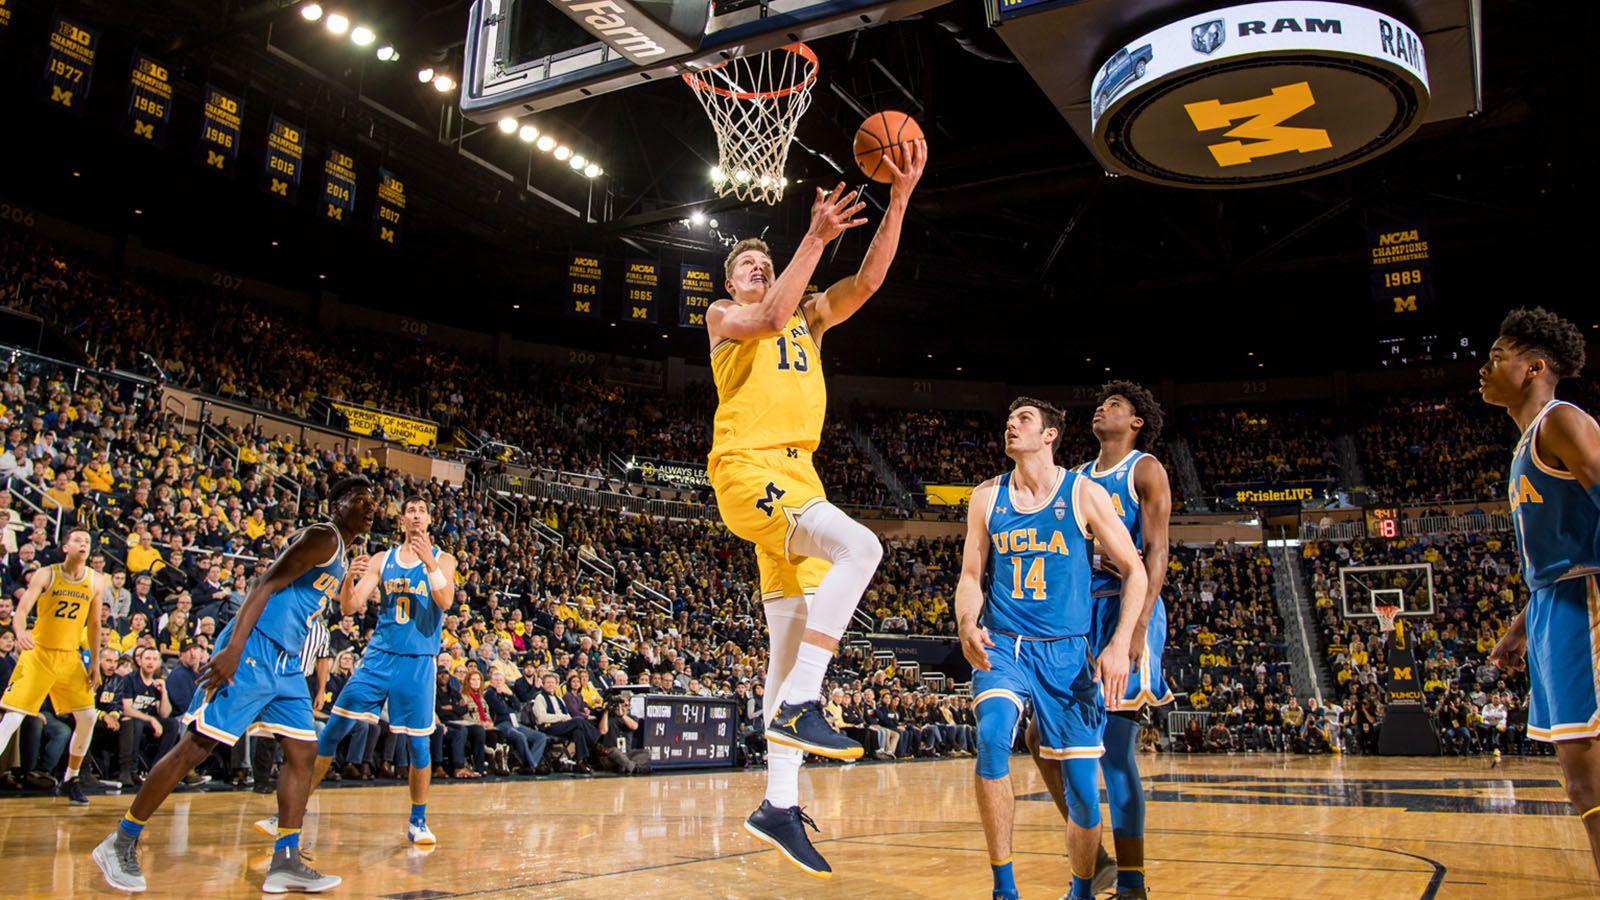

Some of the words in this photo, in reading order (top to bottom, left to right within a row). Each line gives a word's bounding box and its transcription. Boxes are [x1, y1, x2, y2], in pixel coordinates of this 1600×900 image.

[568, 1, 667, 58] Farm
[51, 32, 96, 59] CHAMPIONS
[1237, 18, 1343, 37] RAM
[1379, 18, 1423, 73] RAM
[50, 58, 84, 83] 1977
[50, 84, 73, 107] M
[133, 95, 165, 118] 1985
[133, 119, 155, 140] M
[1183, 81, 1333, 167] M
[205, 126, 233, 148] 1986
[207, 150, 225, 170] M
[270, 155, 295, 176] 2012
[270, 177, 288, 197] M
[327, 182, 349, 202] 2014
[327, 203, 343, 221] M
[380, 205, 400, 224] 2017
[380, 226, 394, 244] M
[1379, 229, 1420, 246] NCAA
[1372, 241, 1429, 258] CHAMPIONS
[574, 257, 599, 267] NCAA
[630, 264, 655, 274] NCAA
[686, 271, 711, 280] NCAA
[1384, 269, 1422, 288] 1989
[572, 283, 596, 295] 1964
[629, 289, 653, 302] 1965
[575, 300, 591, 312] M
[632, 307, 647, 319] M
[1393, 295, 1417, 313] M
[776, 336, 809, 372] 13
[384, 416, 395, 425] OF
[396, 418, 437, 435] MICHIGAN
[389, 427, 417, 439] UNION
[787, 447, 798, 459] M
[659, 465, 692, 477] ALWAYS
[756, 482, 786, 517] M
[1379, 519, 1396, 538] 18
[992, 528, 1069, 556] UCLA
[1011, 556, 1047, 600] 14
[52, 590, 90, 601] MICHIGAN
[384, 579, 428, 598] UCLA
[55, 601, 80, 619] 22
[396, 597, 410, 624] 0
[1393, 666, 1412, 681] M
[682, 704, 706, 723] 9:41
[656, 723, 666, 736] 14
[718, 722, 727, 737] 18
[709, 744, 715, 759] 3
